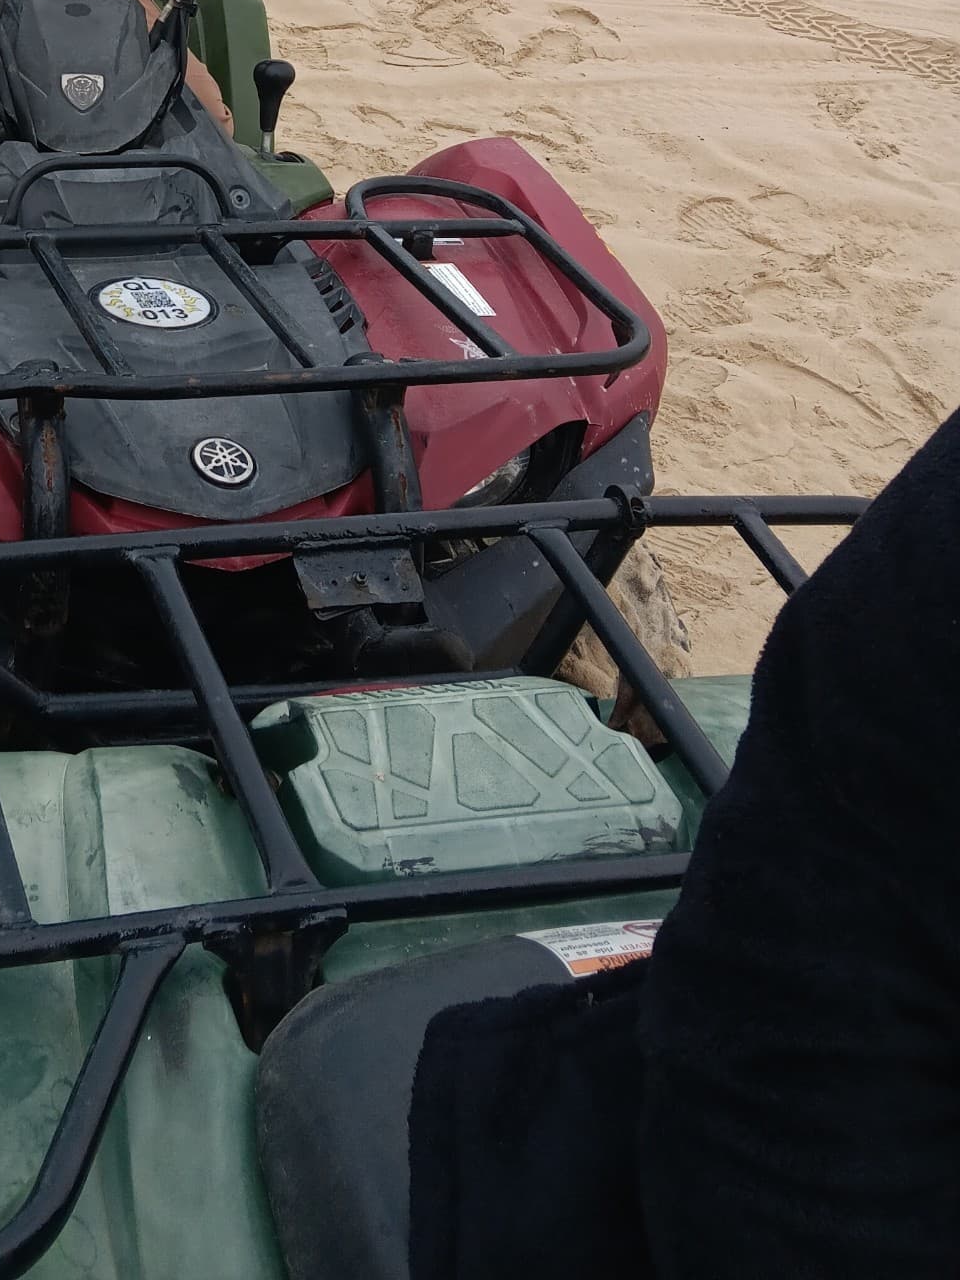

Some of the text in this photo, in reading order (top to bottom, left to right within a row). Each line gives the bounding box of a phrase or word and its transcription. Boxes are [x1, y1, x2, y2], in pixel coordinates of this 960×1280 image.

[123, 281, 162, 291] QL
[142, 308, 189, 320] 013
[560, 940, 610, 951] passenger
